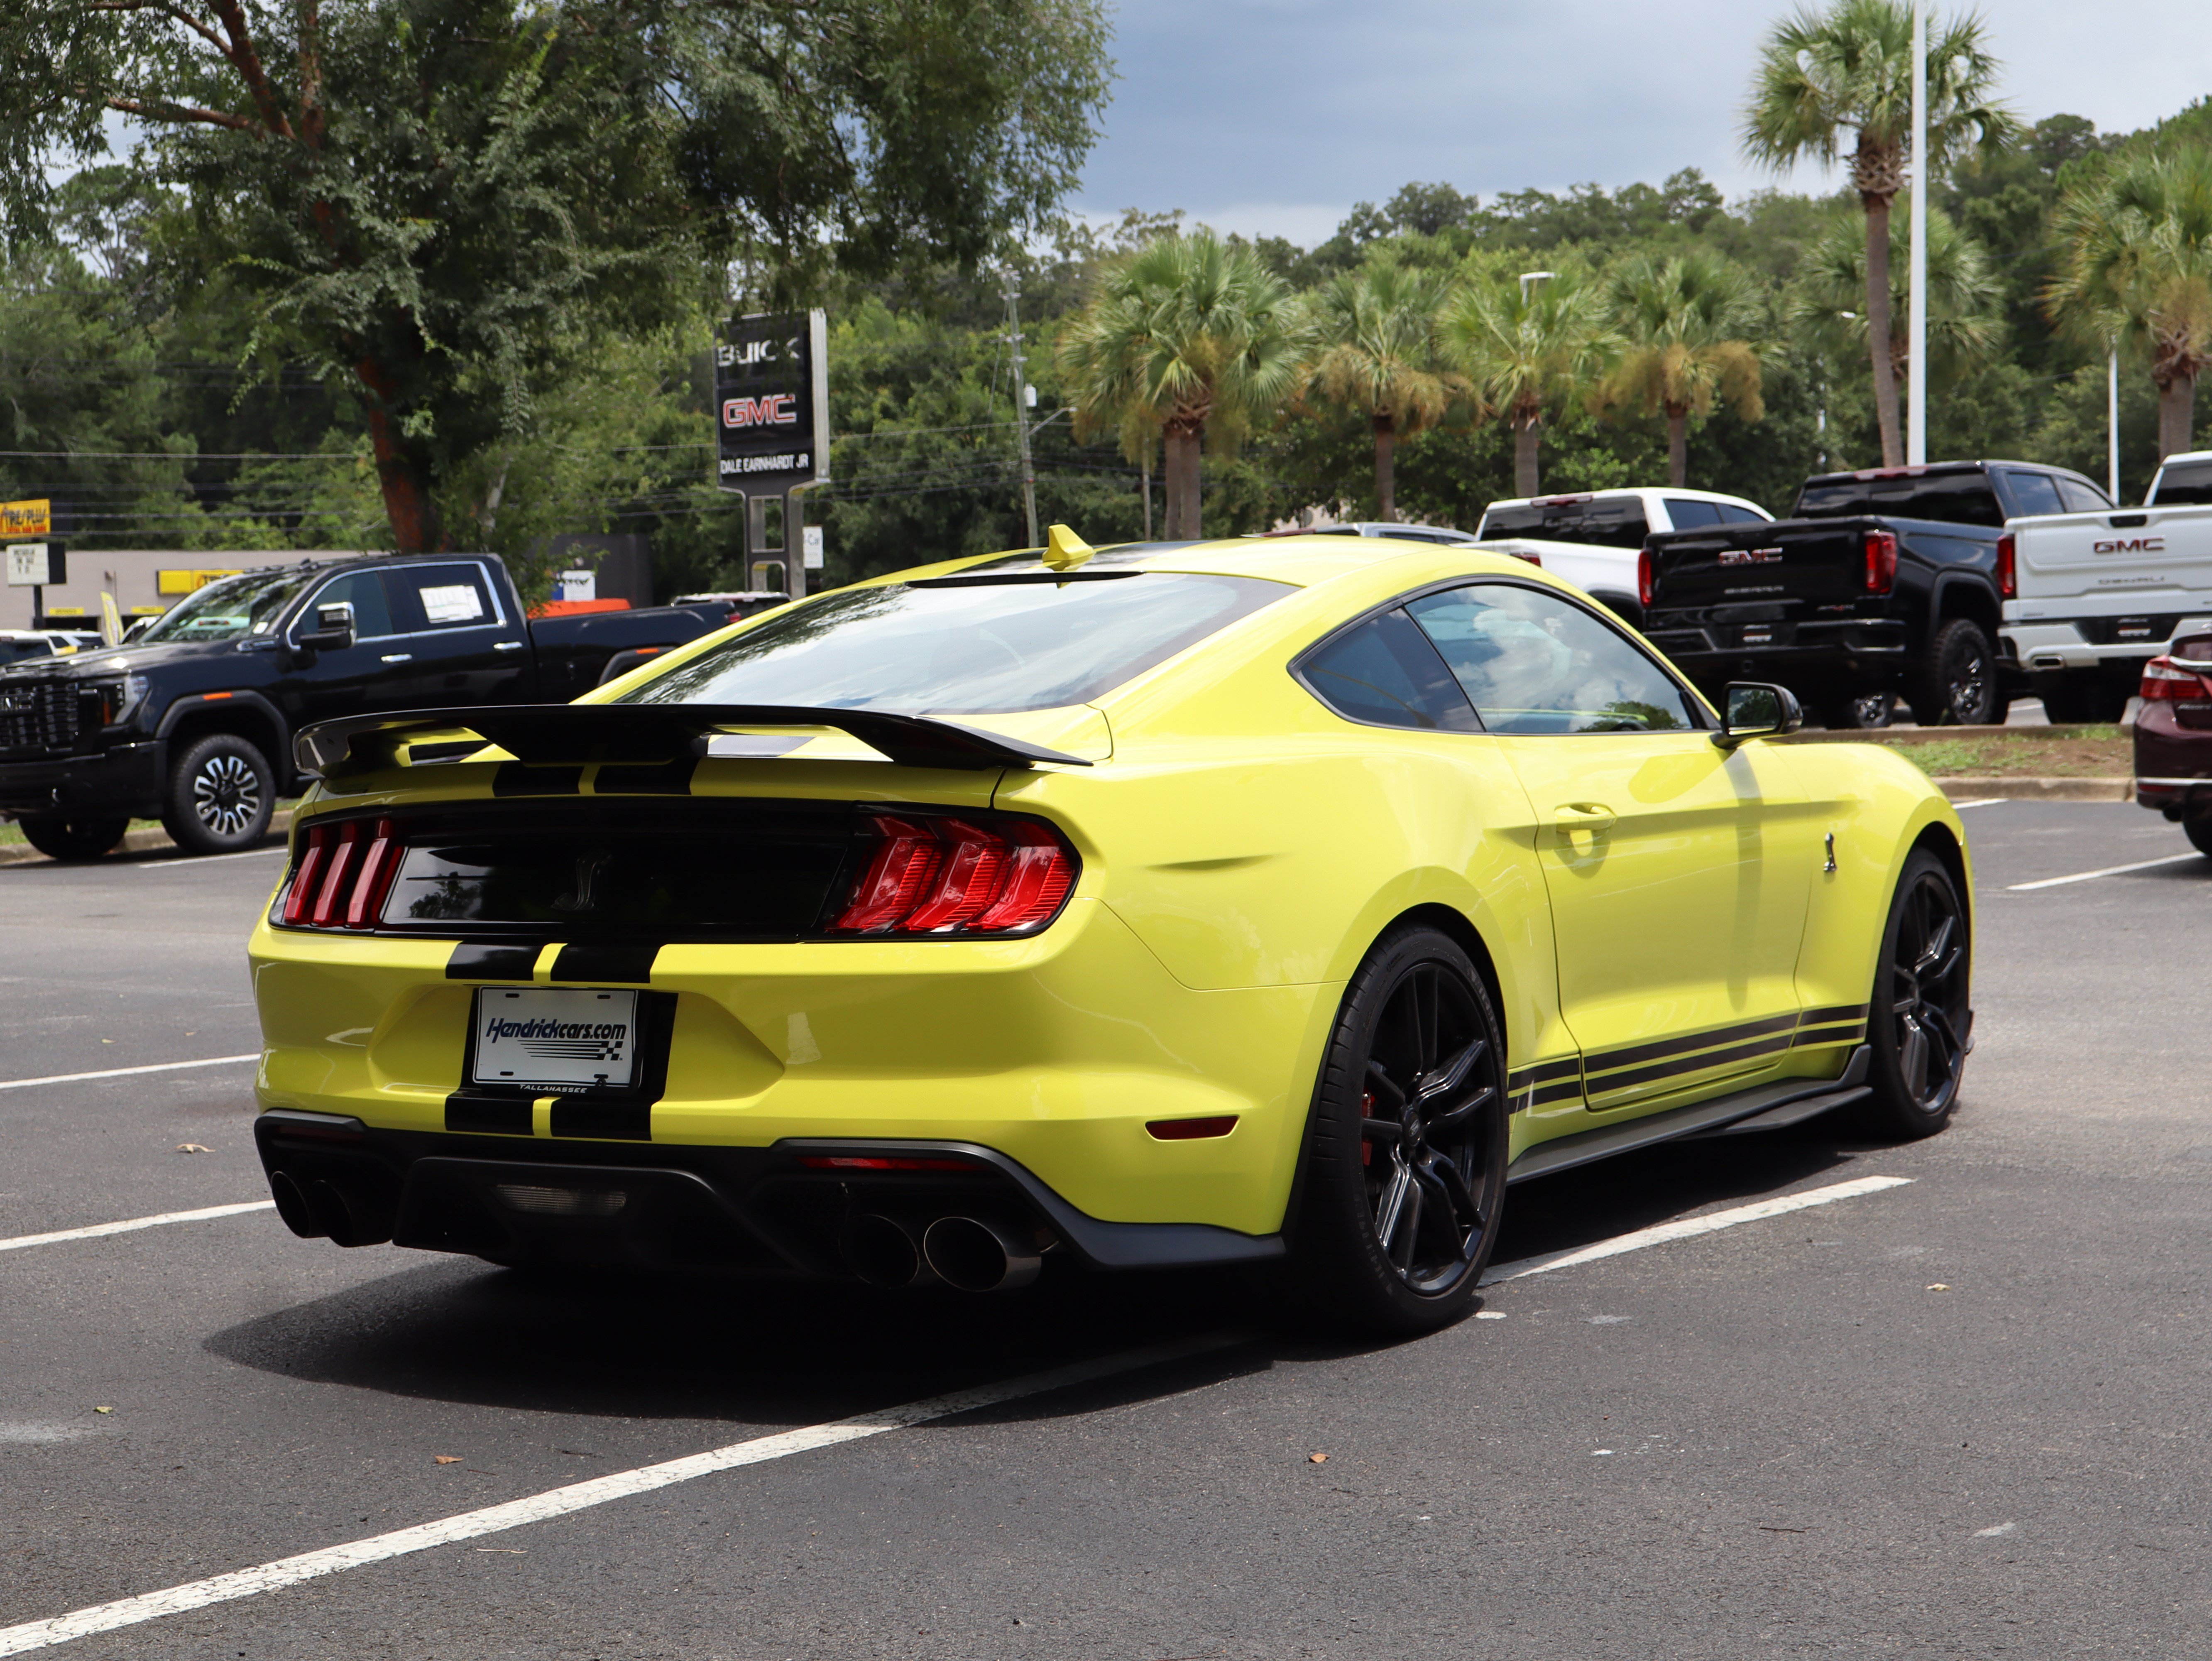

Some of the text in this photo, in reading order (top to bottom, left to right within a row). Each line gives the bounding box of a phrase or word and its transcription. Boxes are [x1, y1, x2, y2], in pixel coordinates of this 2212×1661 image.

[722, 394, 797, 429] GMC
[720, 453, 809, 475] DALE EARNHARDT JR
[2093, 536, 2166, 554] GMC
[1719, 547, 1783, 566] GMC
[486, 1018, 627, 1044] Hendrickcars.com
[519, 1084, 587, 1093] TALLAHASSEE
